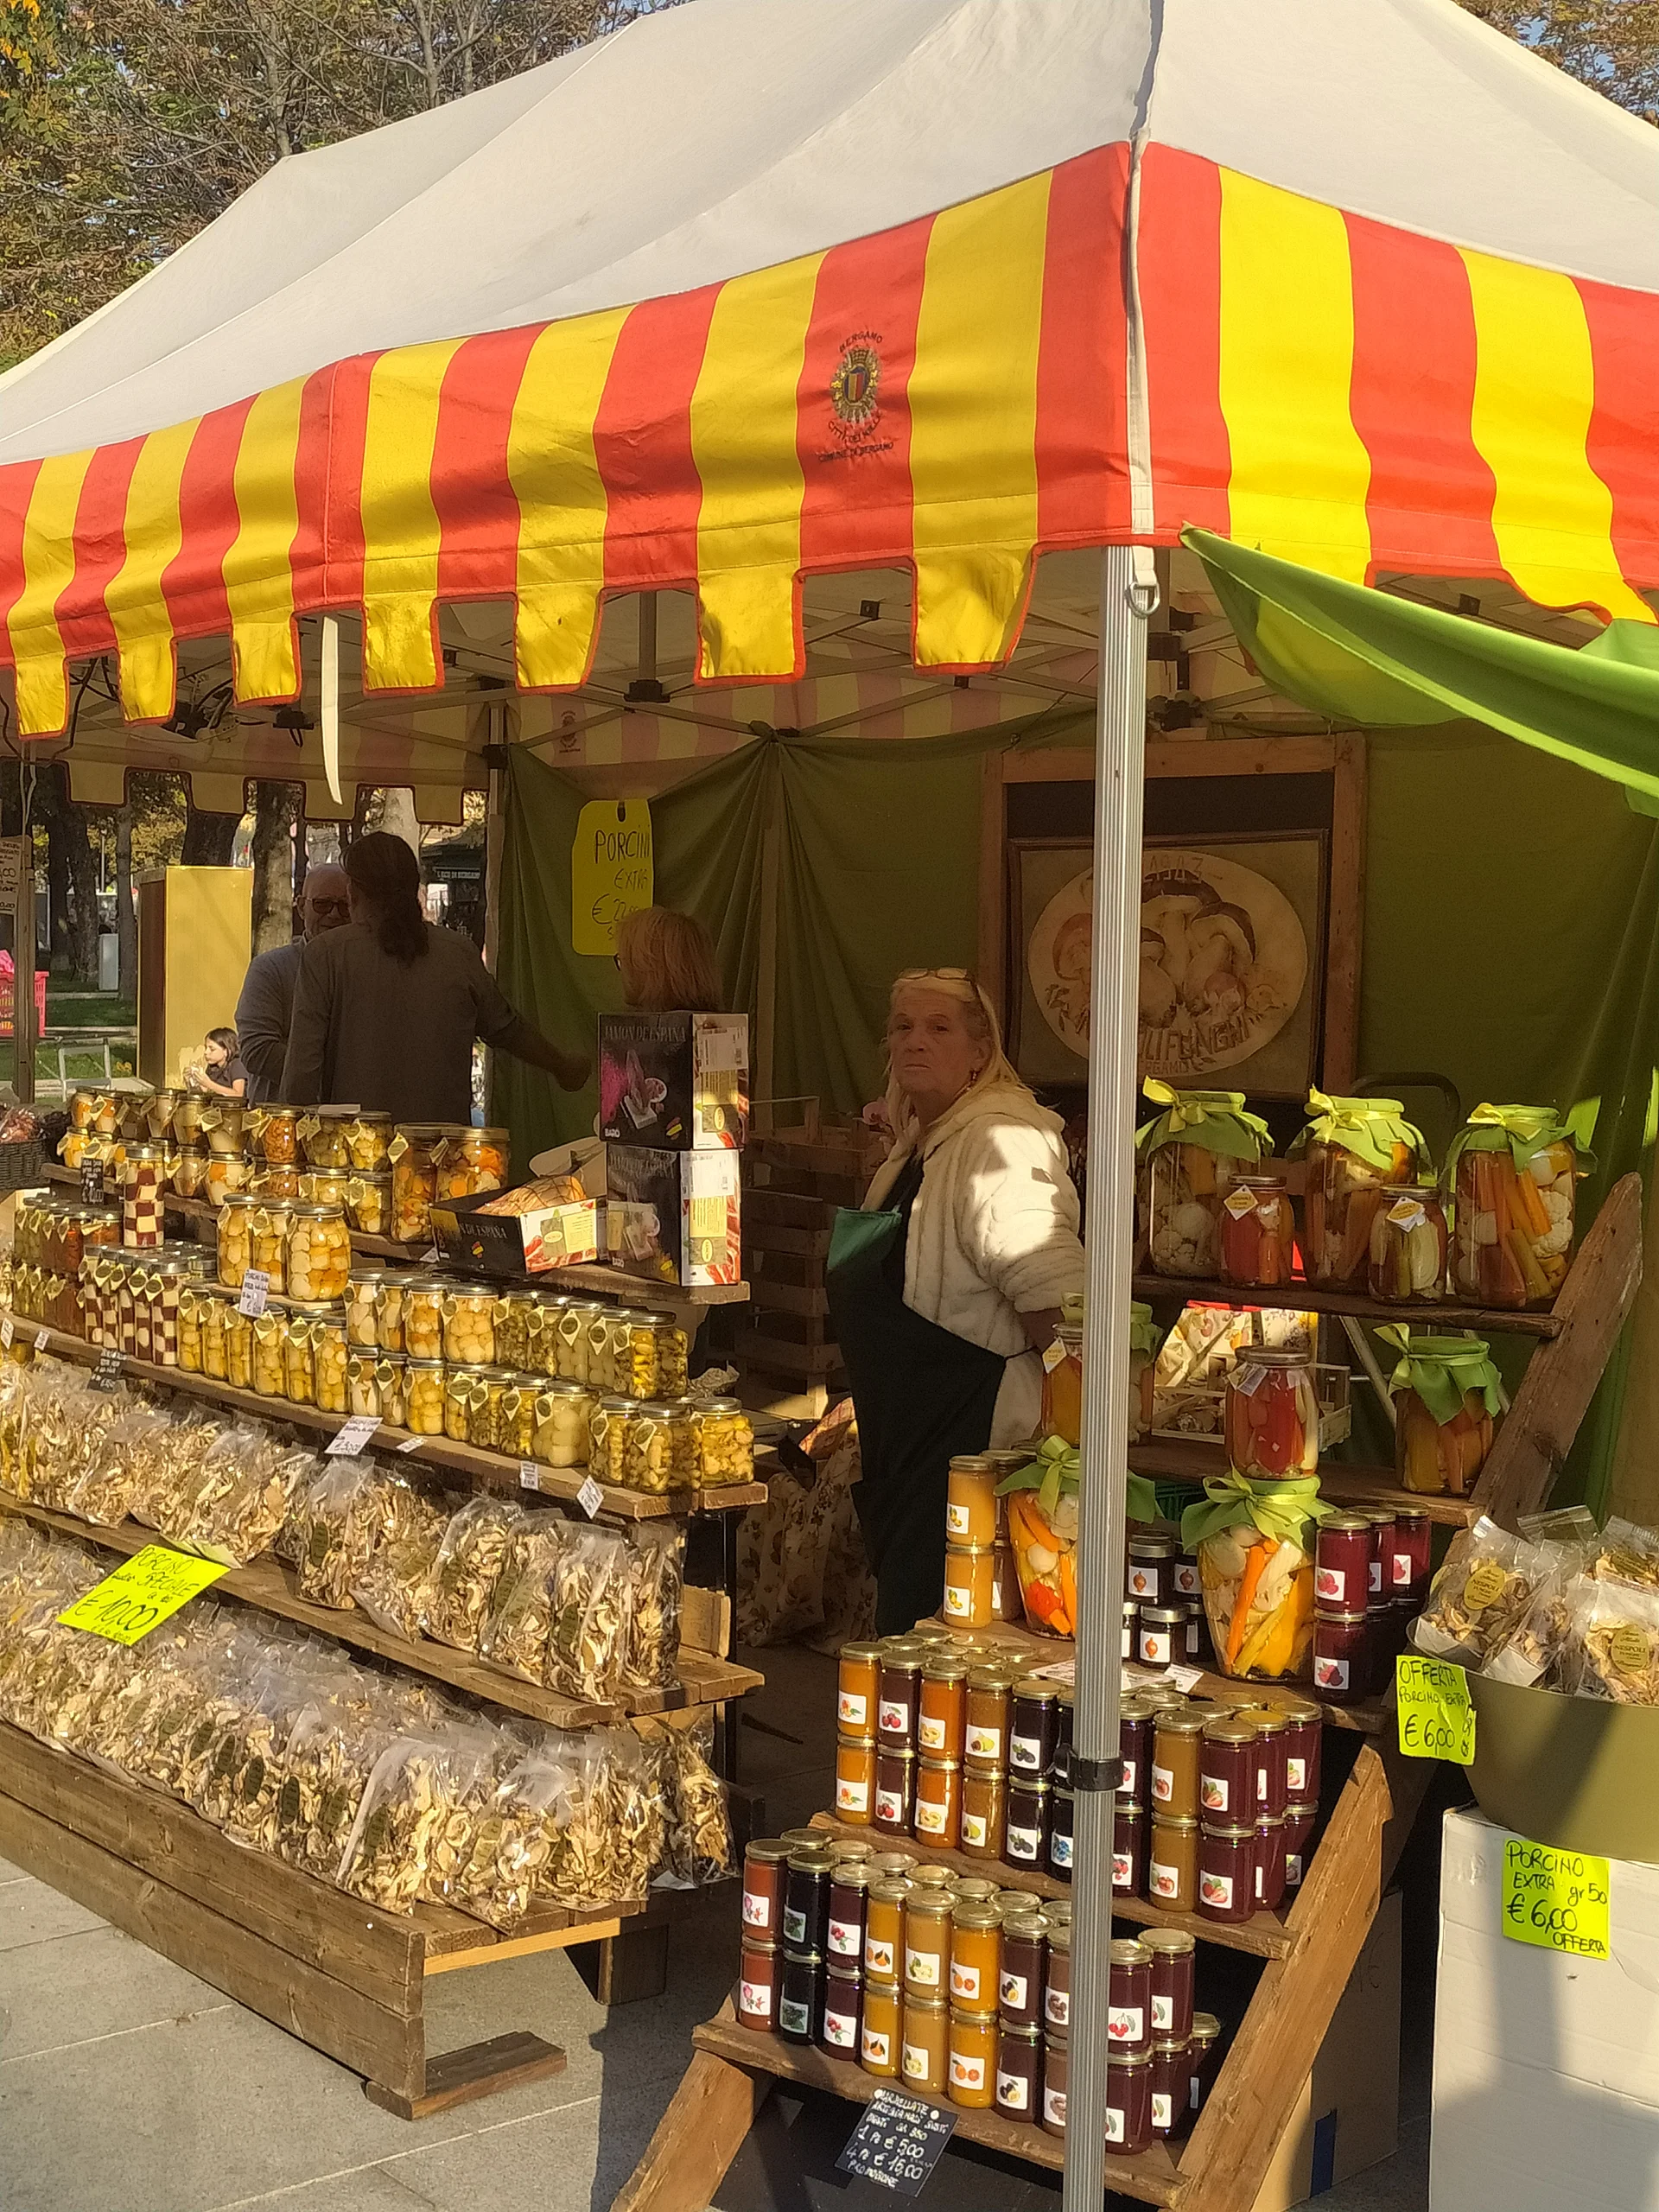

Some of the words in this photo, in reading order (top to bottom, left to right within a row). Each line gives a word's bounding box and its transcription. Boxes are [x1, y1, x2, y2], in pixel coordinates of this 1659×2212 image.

[839, 330, 883, 353] BERGAMO
[860, 442, 894, 457] BERGAMO
[132, 1547, 194, 1574] PORCINO
[93, 1595, 159, 1631] 10,00
[1613, 1644, 1646, 1654] NESPOLI
[1399, 1660, 1458, 1687] OFFERTA
[1423, 1719, 1456, 1756] 6,00
[1505, 1840, 1584, 1878] PORCINO
[1513, 1872, 1555, 1891] EXTRA
[1567, 1886, 1585, 1907] gr
[1588, 1883, 1608, 1905] 50
[1530, 1899, 1578, 1935] 6,00
[1552, 1931, 1607, 1954] OFFERTA
[909, 2127, 928, 2141] 350
[846, 2142, 858, 2159] 4
